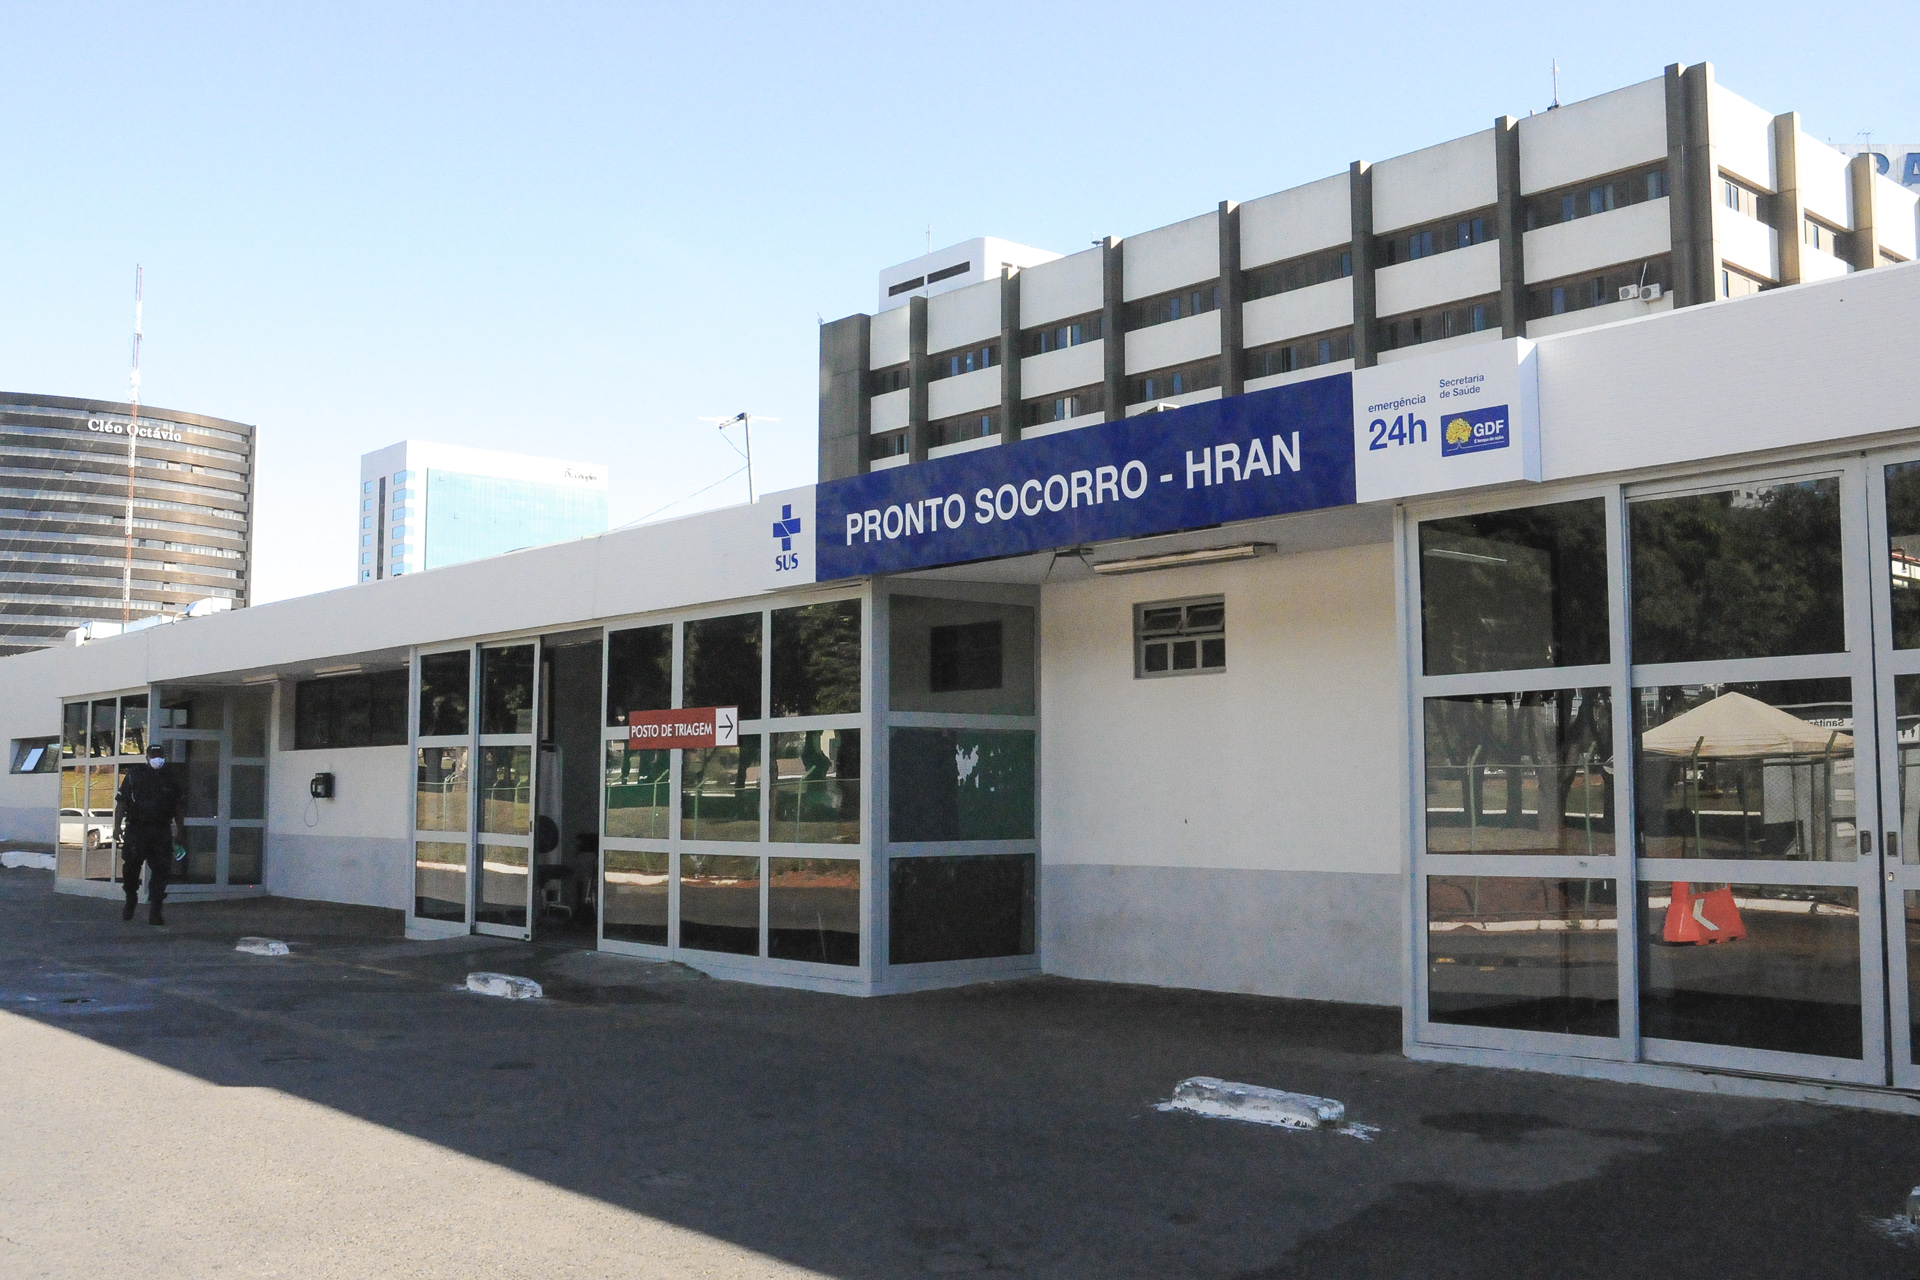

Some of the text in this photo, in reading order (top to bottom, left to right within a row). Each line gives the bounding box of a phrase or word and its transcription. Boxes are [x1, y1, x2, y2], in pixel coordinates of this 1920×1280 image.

[1439, 373, 1485, 388] Secretaria
[1439, 385, 1481, 399] de Saúde
[1368, 394, 1426, 413] emergência
[87, 419, 182, 442] Cléo Octávio
[1369, 412, 1427, 451] 24h
[1473, 419, 1505, 437] GDF
[846, 493, 966, 546] PRONTO
[974, 459, 1148, 525] SOCORRO
[1186, 431, 1300, 489] HRAN
[775, 552, 799, 572] SUS
[631, 722, 713, 738] POSTO DE TRIAGEM
